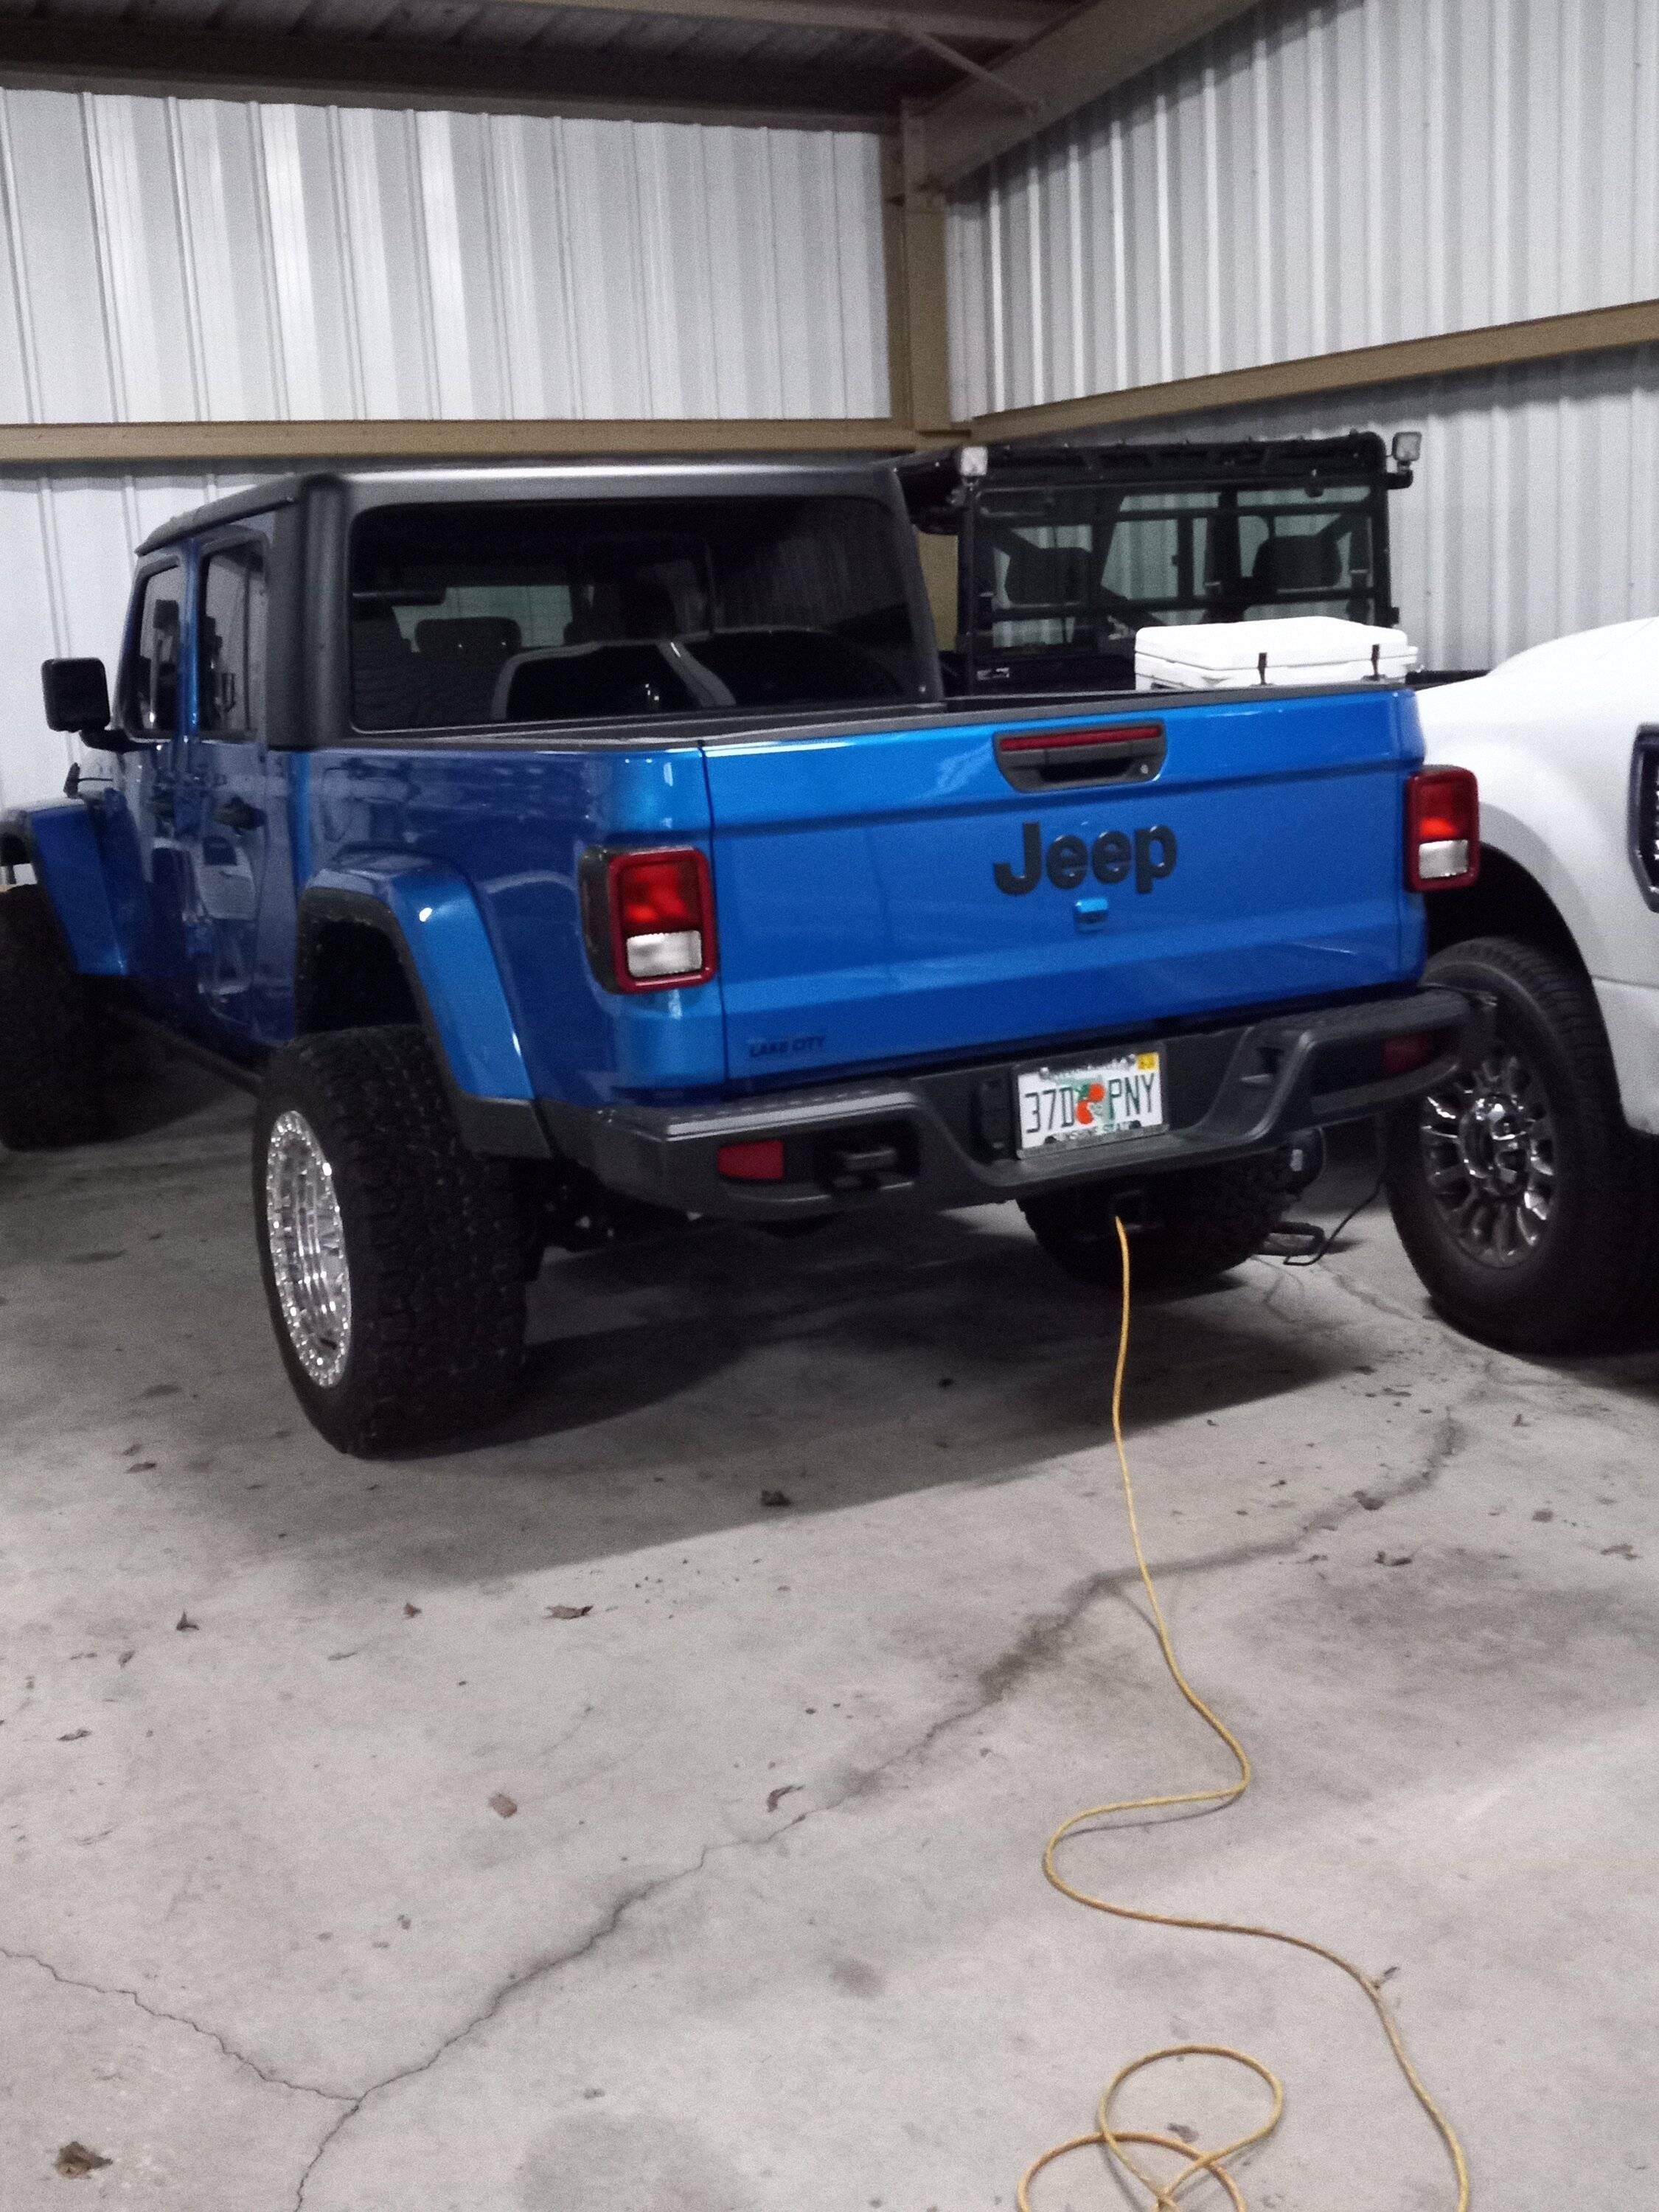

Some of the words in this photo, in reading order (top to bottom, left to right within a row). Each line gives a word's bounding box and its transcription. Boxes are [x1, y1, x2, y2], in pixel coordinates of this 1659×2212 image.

[994, 821, 1178, 896] Jeep
[1024, 1086, 1076, 1133] 37D
[1108, 1073, 1155, 1120] PNY
